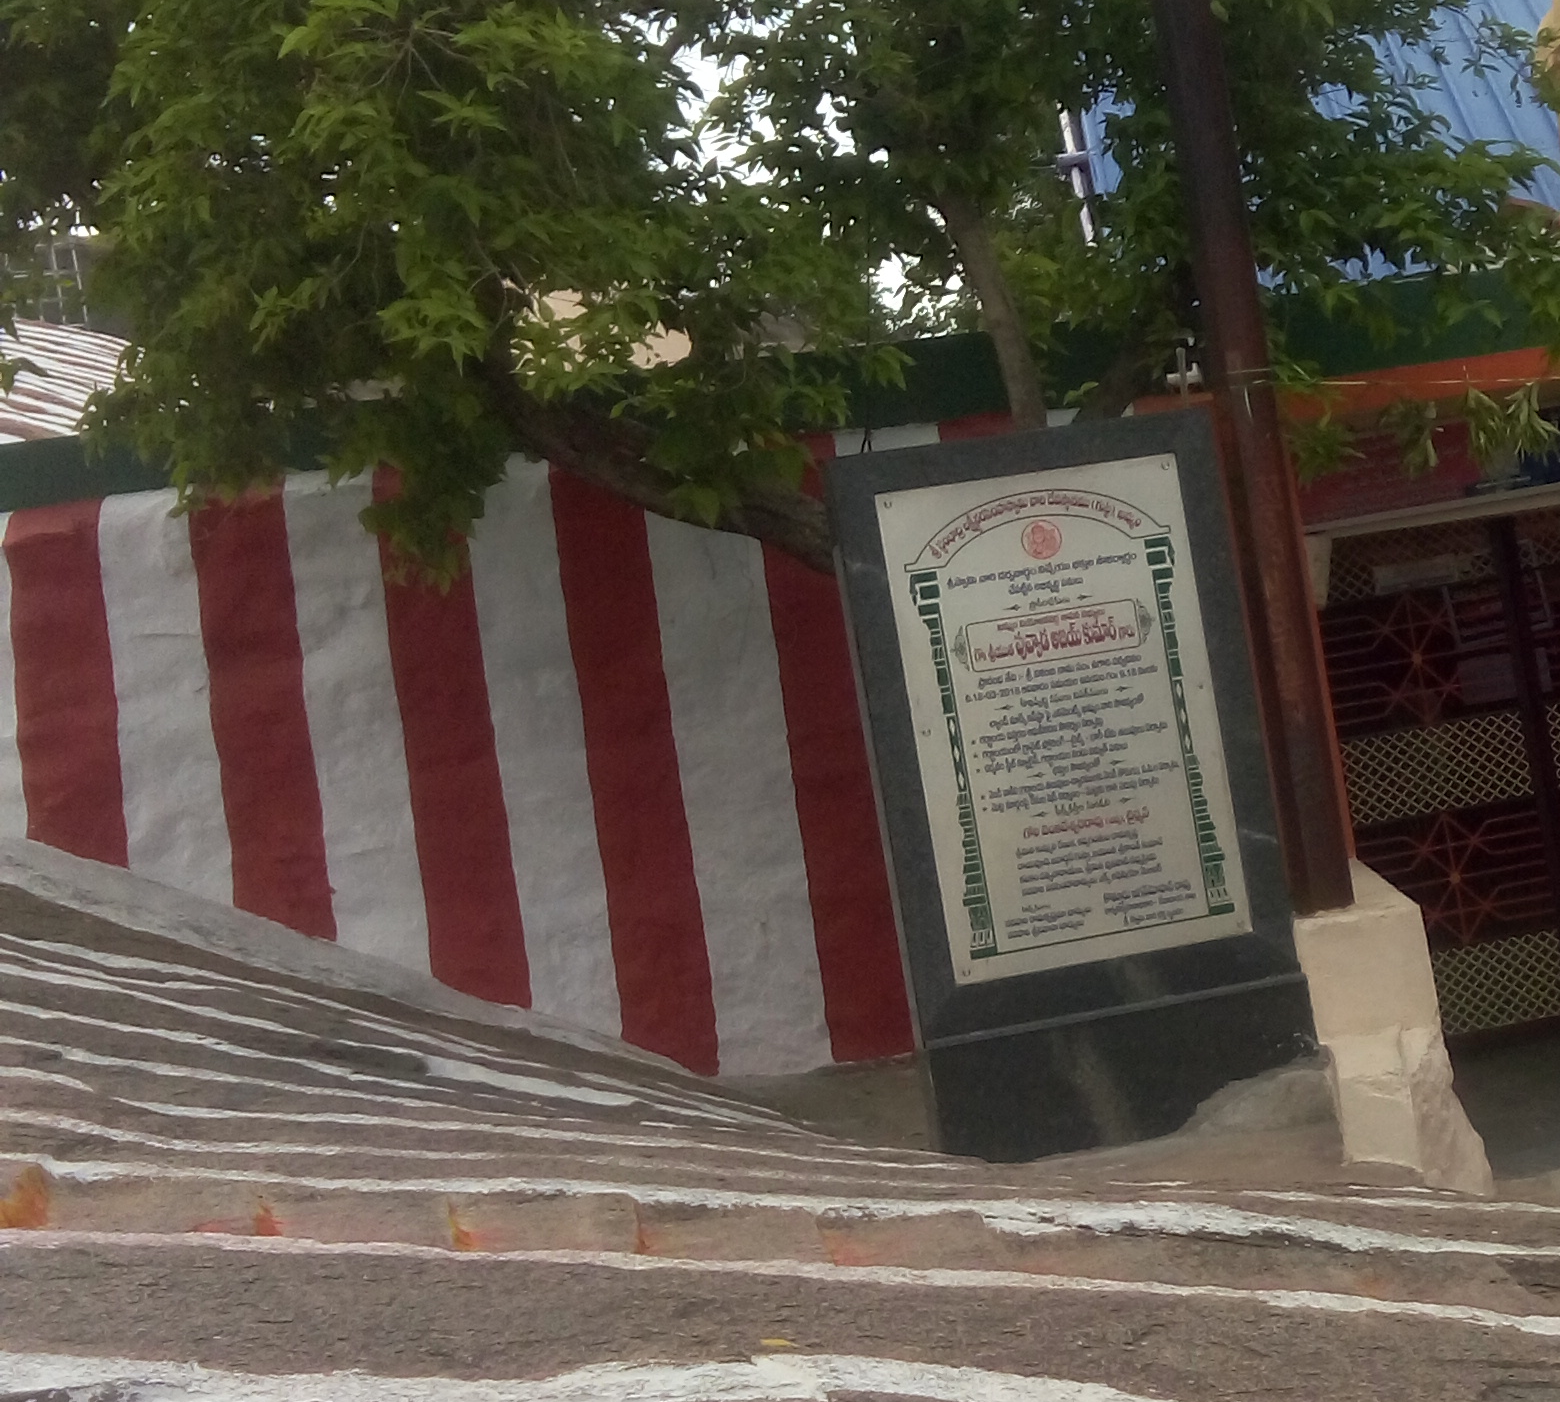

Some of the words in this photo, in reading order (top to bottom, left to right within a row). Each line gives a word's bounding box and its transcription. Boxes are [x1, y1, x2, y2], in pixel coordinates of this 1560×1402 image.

[1013, 626, 1050, 660] పువ్వాడ
[1049, 621, 1082, 649] అజయ్
[1080, 615, 1117, 645] కుమార్
[1117, 624, 1135, 640] గారు
